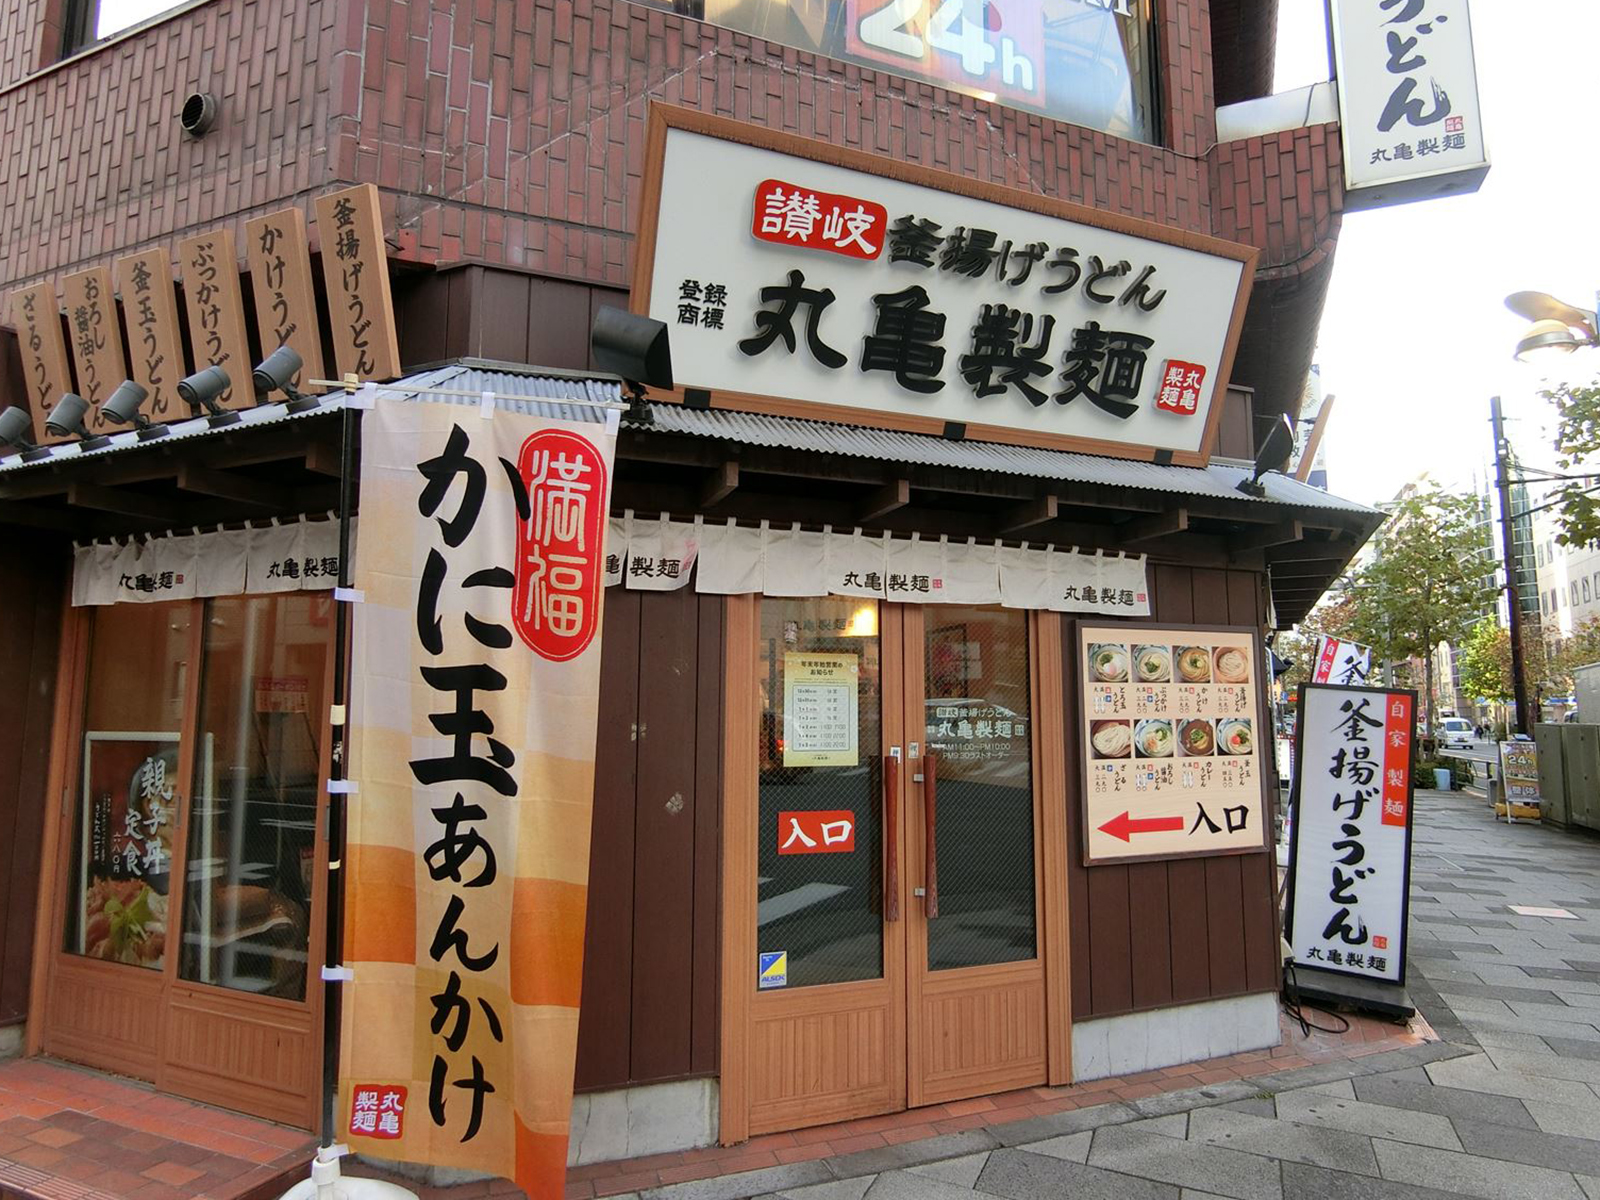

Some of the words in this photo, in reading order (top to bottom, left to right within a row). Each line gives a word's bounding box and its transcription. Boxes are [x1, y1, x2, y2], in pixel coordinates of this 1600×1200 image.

[1370, 133, 1466, 165] 丸亀製麺
[762, 186, 877, 256] 讃岐
[332, 197, 374, 382] 釜揚げうどん
[679, 279, 728, 307] 登録
[887, 214, 1168, 312] 釜揚げうどん
[84, 277, 106, 350] おろし
[131, 261, 169, 415] 釜玉うどん
[677, 303, 724, 330] 商標
[736, 270, 1154, 420] 丸亀製麺
[267, 557, 339, 579] 丸亀製麺
[524, 449, 592, 638] 満福
[843, 571, 930, 593] 丸亀製麺
[1063, 585, 1134, 606] 丸亀製麺
[937, 720, 1012, 739] 丸亀製麺
[960, 707, 1012, 718] 釜揚げうどん
[408, 422, 531, 1143] かに玉あんかけ
[1384, 701, 1406, 817] 自家製麺
[123, 808, 144, 876] 定食
[141, 757, 172, 874] 親子丼
[781, 817, 853, 849] 入口
[1188, 801, 1250, 836] 入口
[1322, 697, 1384, 945] 釜揚げうどん
[1306, 946, 1387, 972] 丸亀製麺
